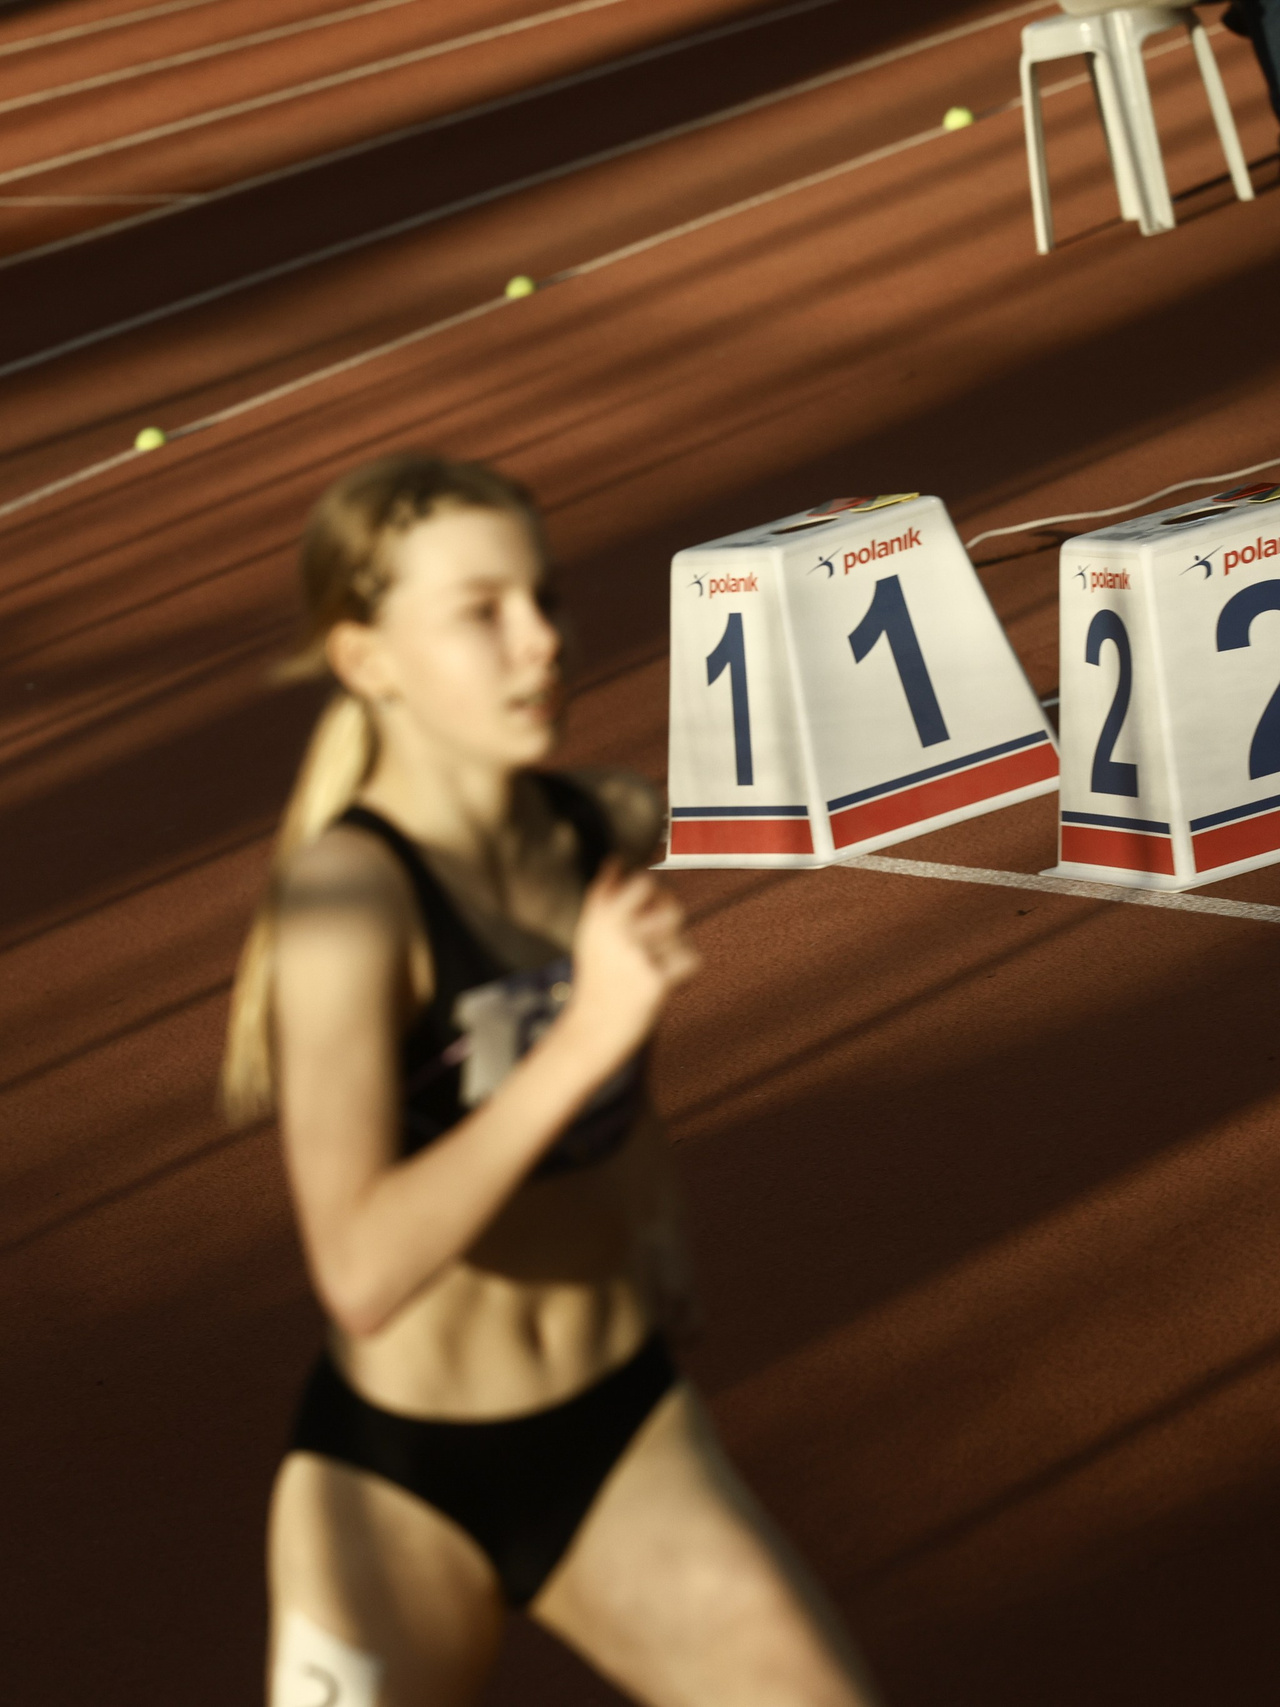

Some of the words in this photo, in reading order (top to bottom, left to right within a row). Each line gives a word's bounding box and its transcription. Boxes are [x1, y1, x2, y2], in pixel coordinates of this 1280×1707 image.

[844, 527, 922, 575] polanik
[1224, 536, 1280, 576] pola
[709, 572, 758, 599] polanik
[1091, 568, 1131, 593] polanik
[848, 574, 950, 748] 1
[706, 612, 754, 786] 1
[1085, 608, 1139, 798] 2
